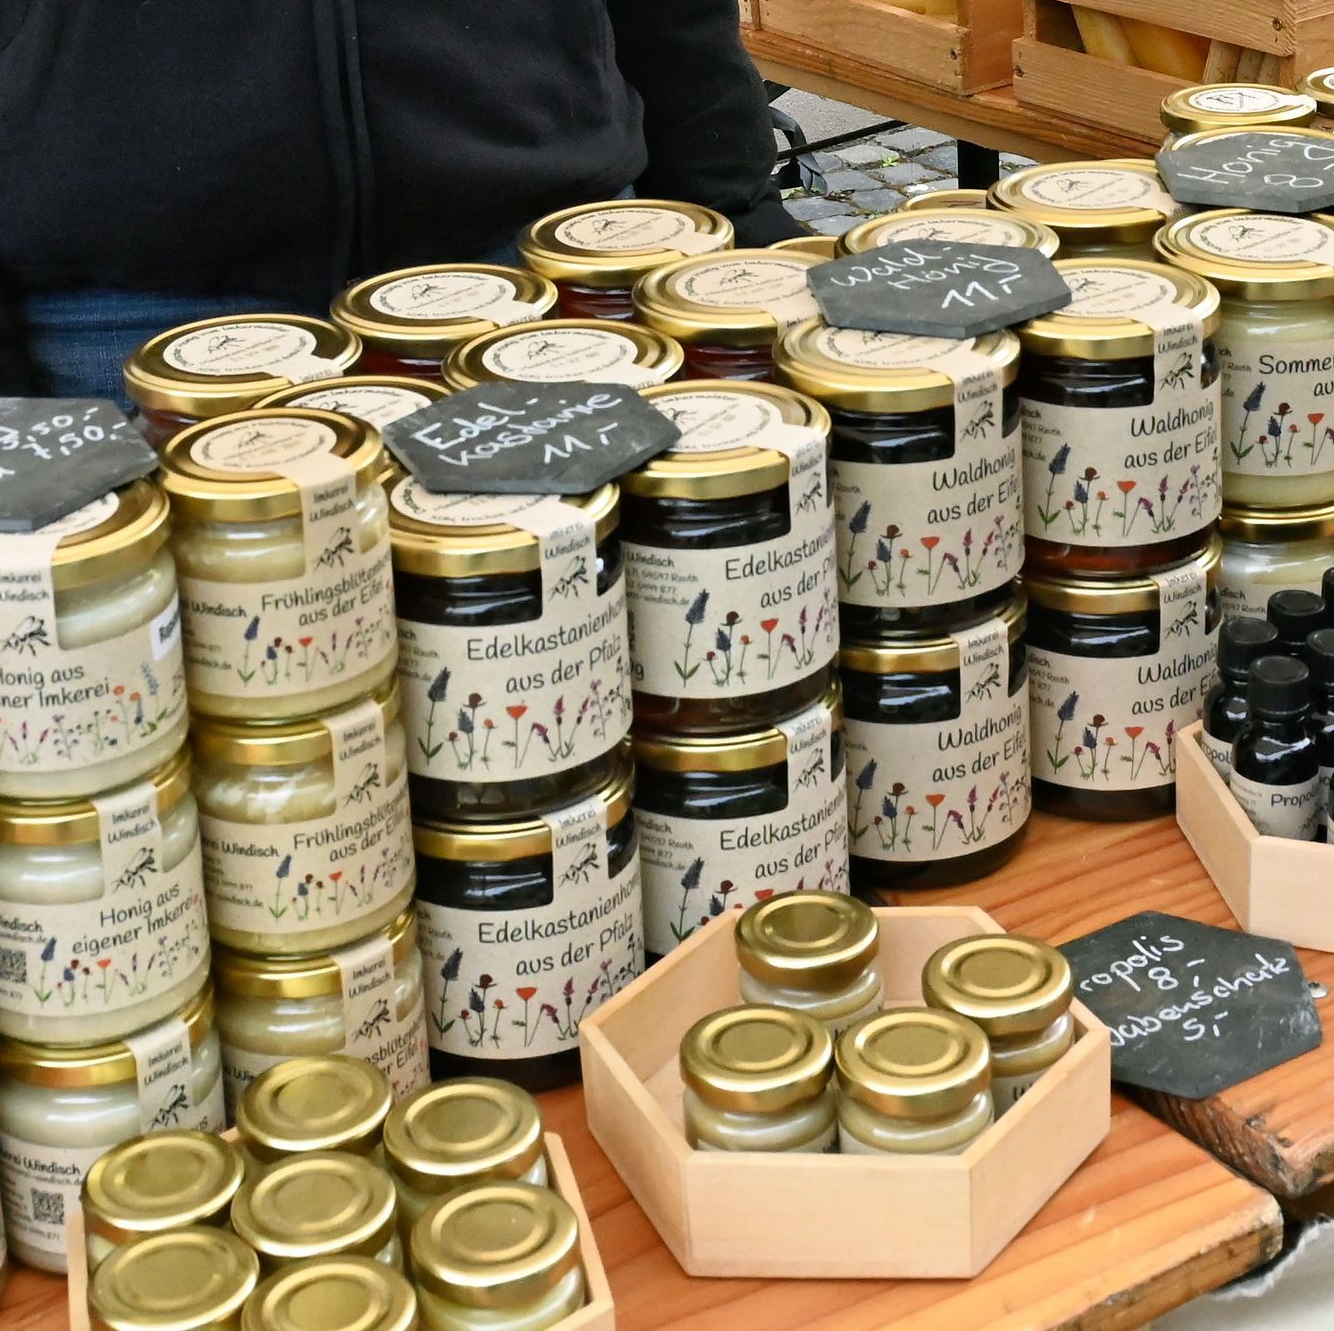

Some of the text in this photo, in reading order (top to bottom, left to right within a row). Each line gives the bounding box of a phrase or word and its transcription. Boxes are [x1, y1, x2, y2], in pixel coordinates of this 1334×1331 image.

[1131, 398, 1213, 437] Waldhonig
[933, 446, 1015, 491] Waldhonig
[1124, 441, 1191, 469] aus der
[928, 492, 994, 524] aus der
[298, 590, 357, 627] aus der
[761, 572, 820, 609] aus der
[38, 680, 112, 707] Imkerei
[50, 665, 86, 686] aus
[505, 658, 584, 695] aus der
[1131, 685, 1198, 716] aus der
[937, 703, 1024, 753] Waldhonig
[932, 752, 1002, 784] aus der
[329, 827, 386, 863] aus der
[755, 842, 821, 879] aus der
[99, 898, 153, 928] Honig
[156, 882, 181, 906] aus
[71, 926, 143, 958] eigener
[516, 956, 555, 976] aus
[561, 942, 595, 968] der
[1079, 935, 1185, 992] ropolis
